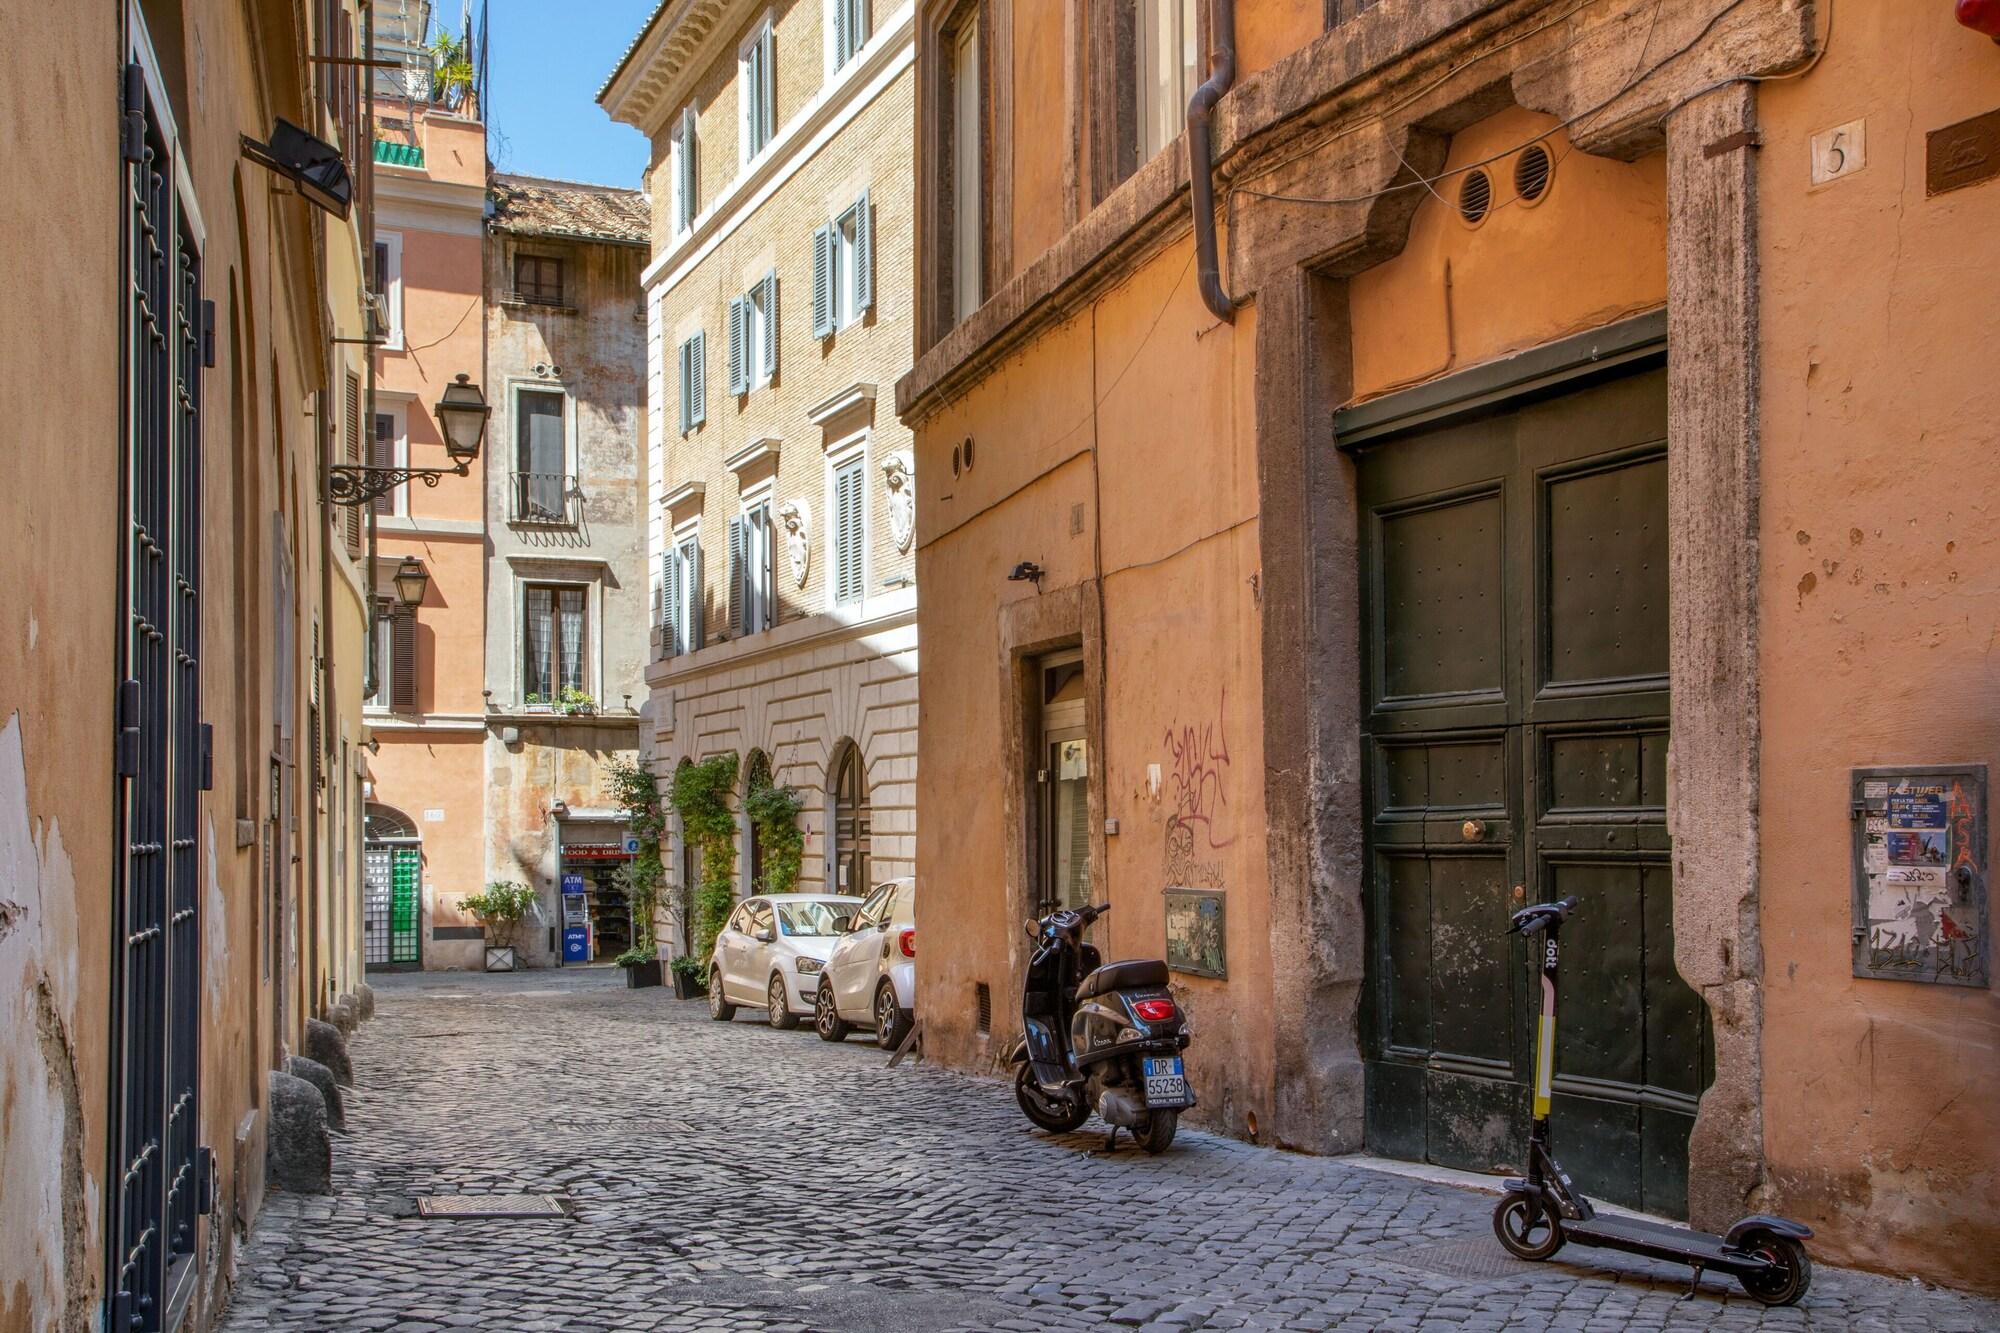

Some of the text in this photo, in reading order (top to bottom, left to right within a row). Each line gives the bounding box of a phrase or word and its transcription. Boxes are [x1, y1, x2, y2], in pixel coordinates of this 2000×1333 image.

[1827, 132, 1845, 174] 5
[564, 876, 582, 884] ATM
[1545, 939, 1558, 969] dott
[1154, 1059, 1168, 1075] DR
[1148, 1078, 1183, 1095] 55238
